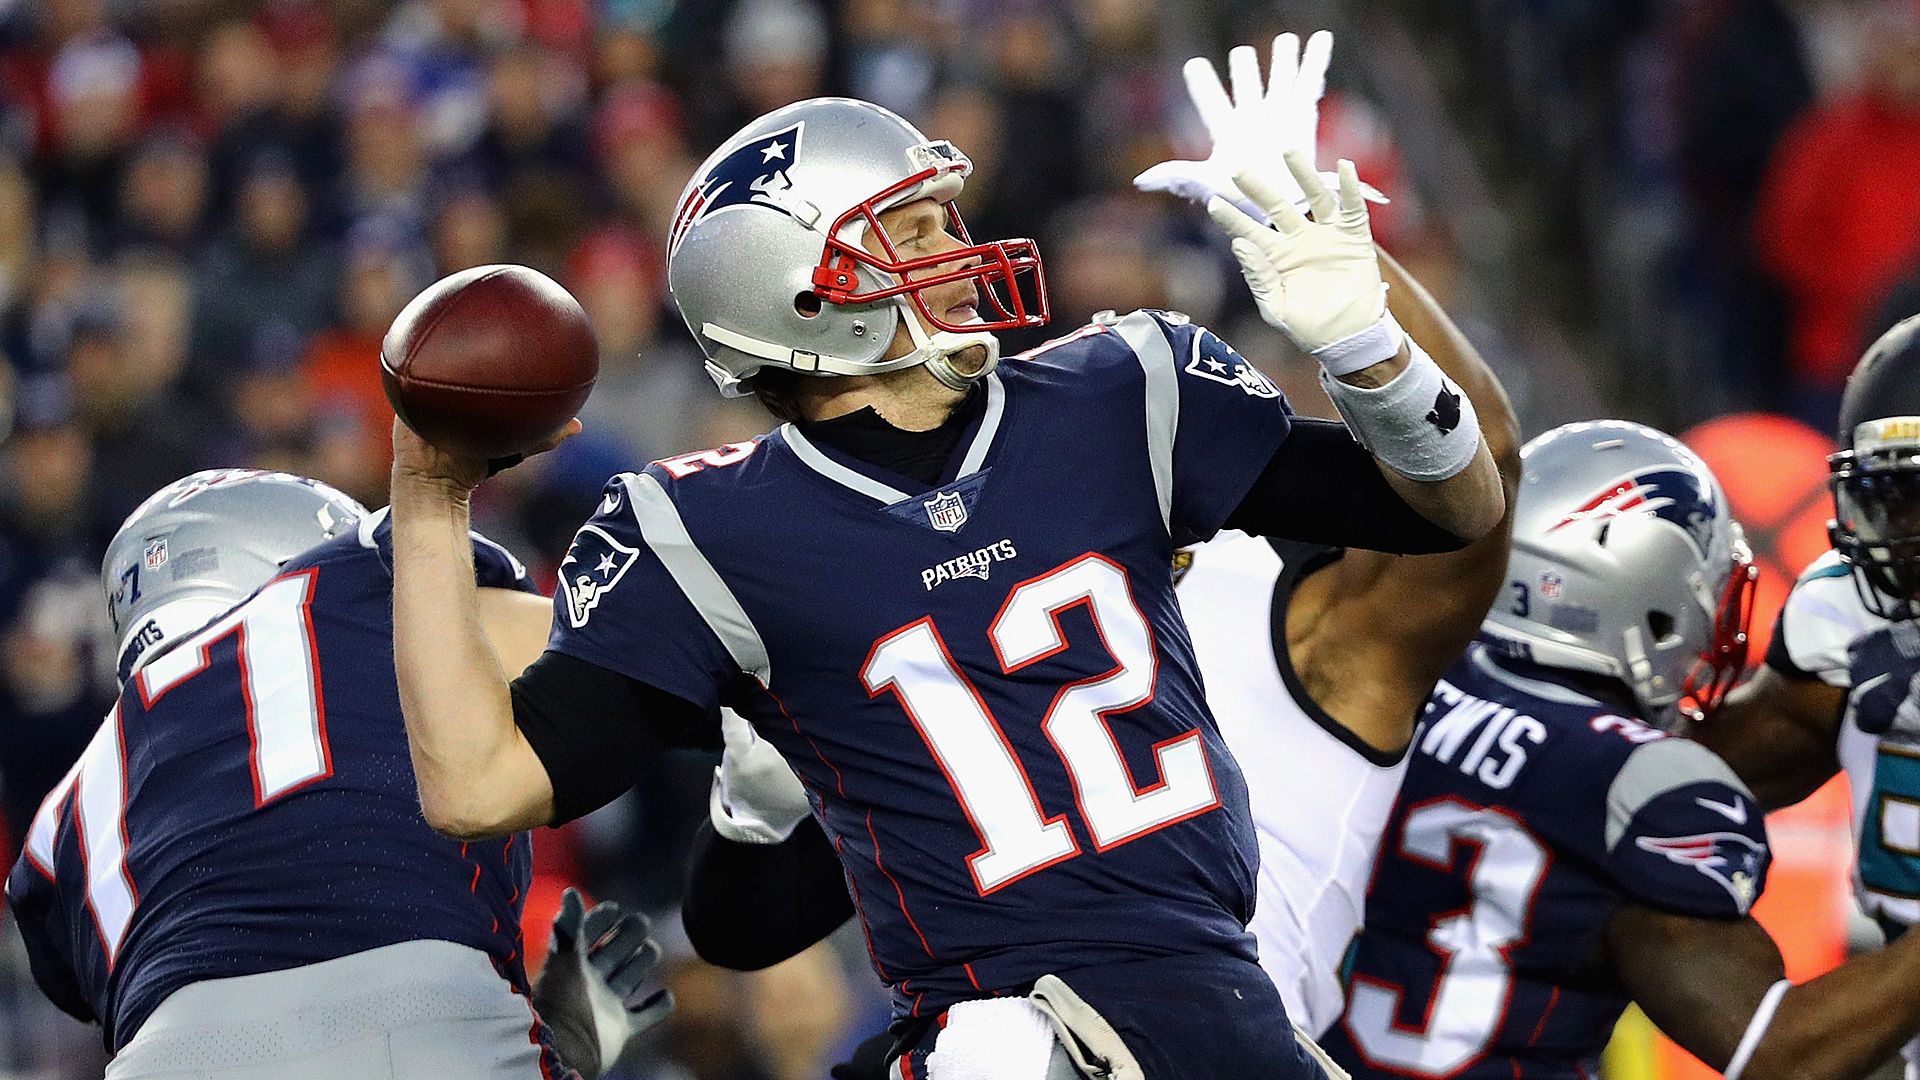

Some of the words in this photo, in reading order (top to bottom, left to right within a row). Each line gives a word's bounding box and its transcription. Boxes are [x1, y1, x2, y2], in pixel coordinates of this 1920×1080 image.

[921, 538, 1018, 591] PATRIOTS
[935, 508, 964, 525] NFL
[857, 551, 1223, 897] 12
[1341, 794, 1555, 1079] 3
